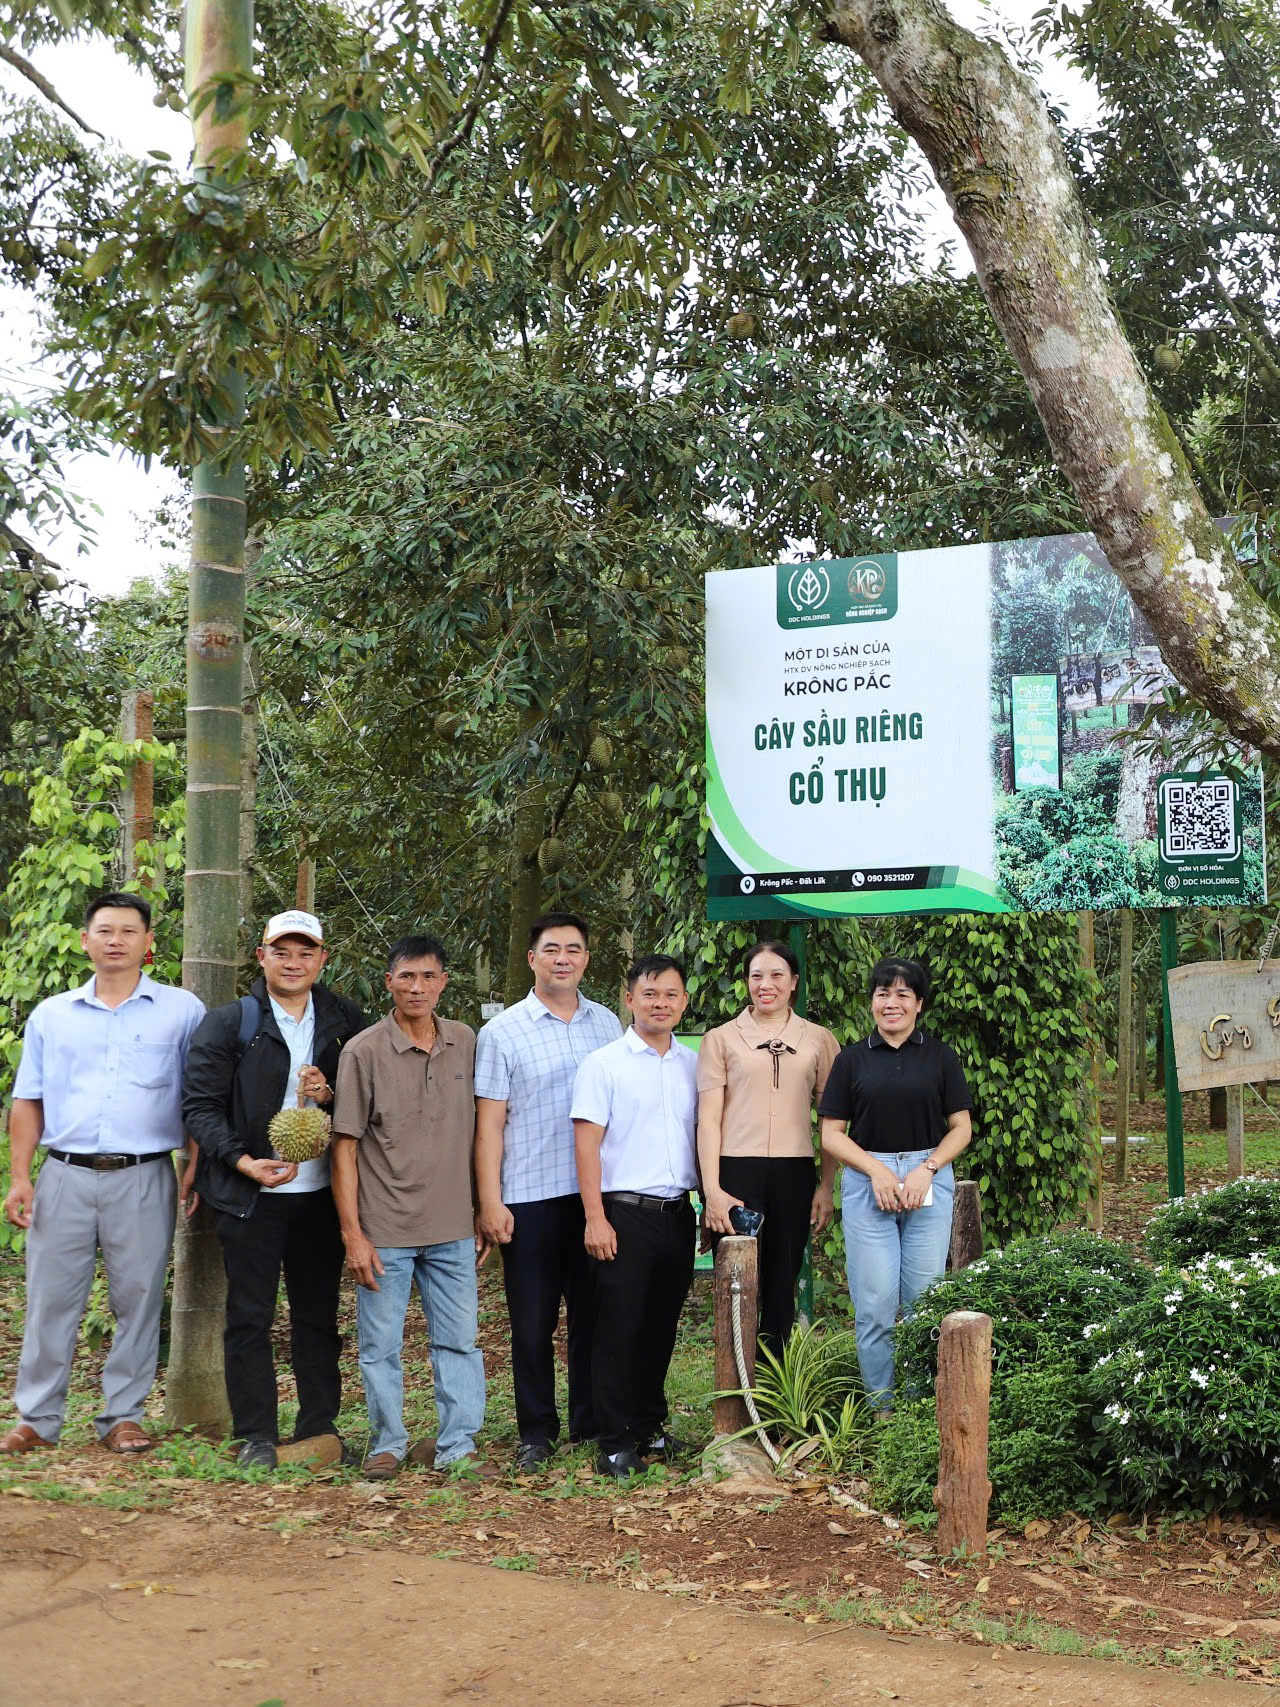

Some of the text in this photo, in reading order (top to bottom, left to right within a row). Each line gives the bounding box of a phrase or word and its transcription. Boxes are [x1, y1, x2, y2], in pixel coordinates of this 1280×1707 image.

[801, 613, 830, 621] HOLDINGS
[784, 640, 891, 663] MỘT DI SẢN CỦA
[814, 663, 837, 672] NÔNG
[784, 668, 891, 697] KRÔNG PẮC
[754, 708, 923, 751] CÂY SẦU RIÊNG
[789, 756, 886, 808] CỔ THỤ
[866, 873, 915, 882] 090 3521207
[1182, 877, 1240, 886] DDC HOLDINGS
[759, 878, 780, 888] Krông
